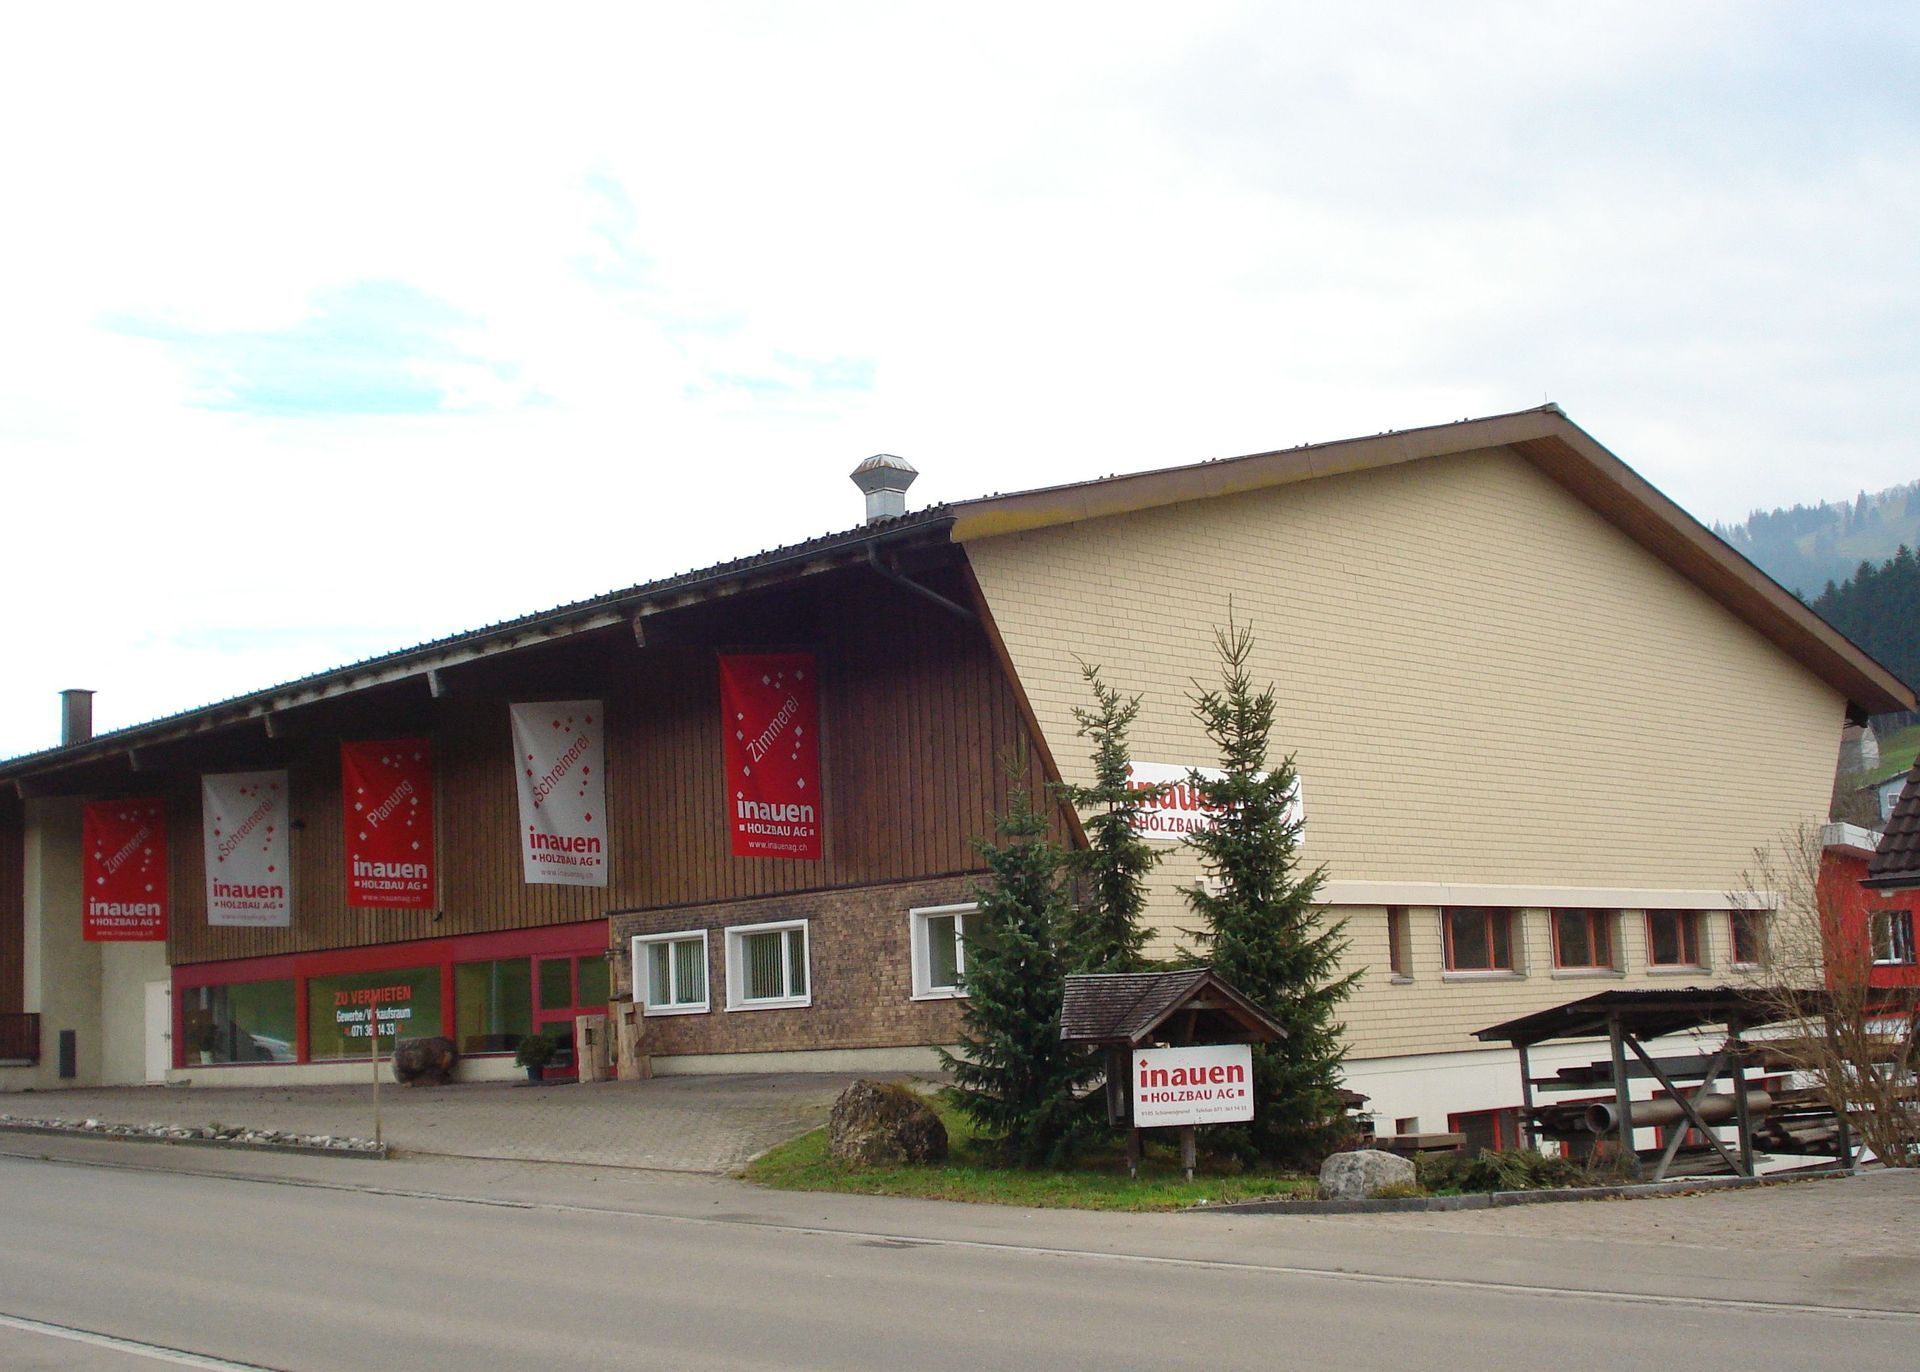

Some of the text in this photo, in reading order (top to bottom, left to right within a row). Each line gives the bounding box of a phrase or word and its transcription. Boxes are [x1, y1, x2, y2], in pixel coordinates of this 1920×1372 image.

[746, 692, 800, 763] Zimmerei
[532, 731, 591, 803] Schreinerei
[366, 779, 413, 829] Planung
[737, 790, 814, 823] inauen
[747, 823, 808, 837] HOLZBAU AG
[1139, 814, 1203, 834] HOLZBAU
[529, 825, 601, 853] inauen
[353, 854, 428, 879] inauen
[538, 853, 594, 867] HOLZBAU AG
[213, 877, 284, 899] inauen
[361, 880, 422, 891] HOLZBAU AG
[89, 896, 161, 917] inauen
[220, 900, 277, 910] HOLZBAU AG
[96, 917, 154, 926] HOLZBAU AG
[334, 984, 412, 1006] ZU VERMIETEN
[351, 1024, 363, 1037] 071
[378, 1024, 385, 1036] 14
[386, 1023, 395, 1036] 33
[1139, 1058, 1245, 1088] inauen
[1151, 1088, 1235, 1103] HOLZBAU AG
